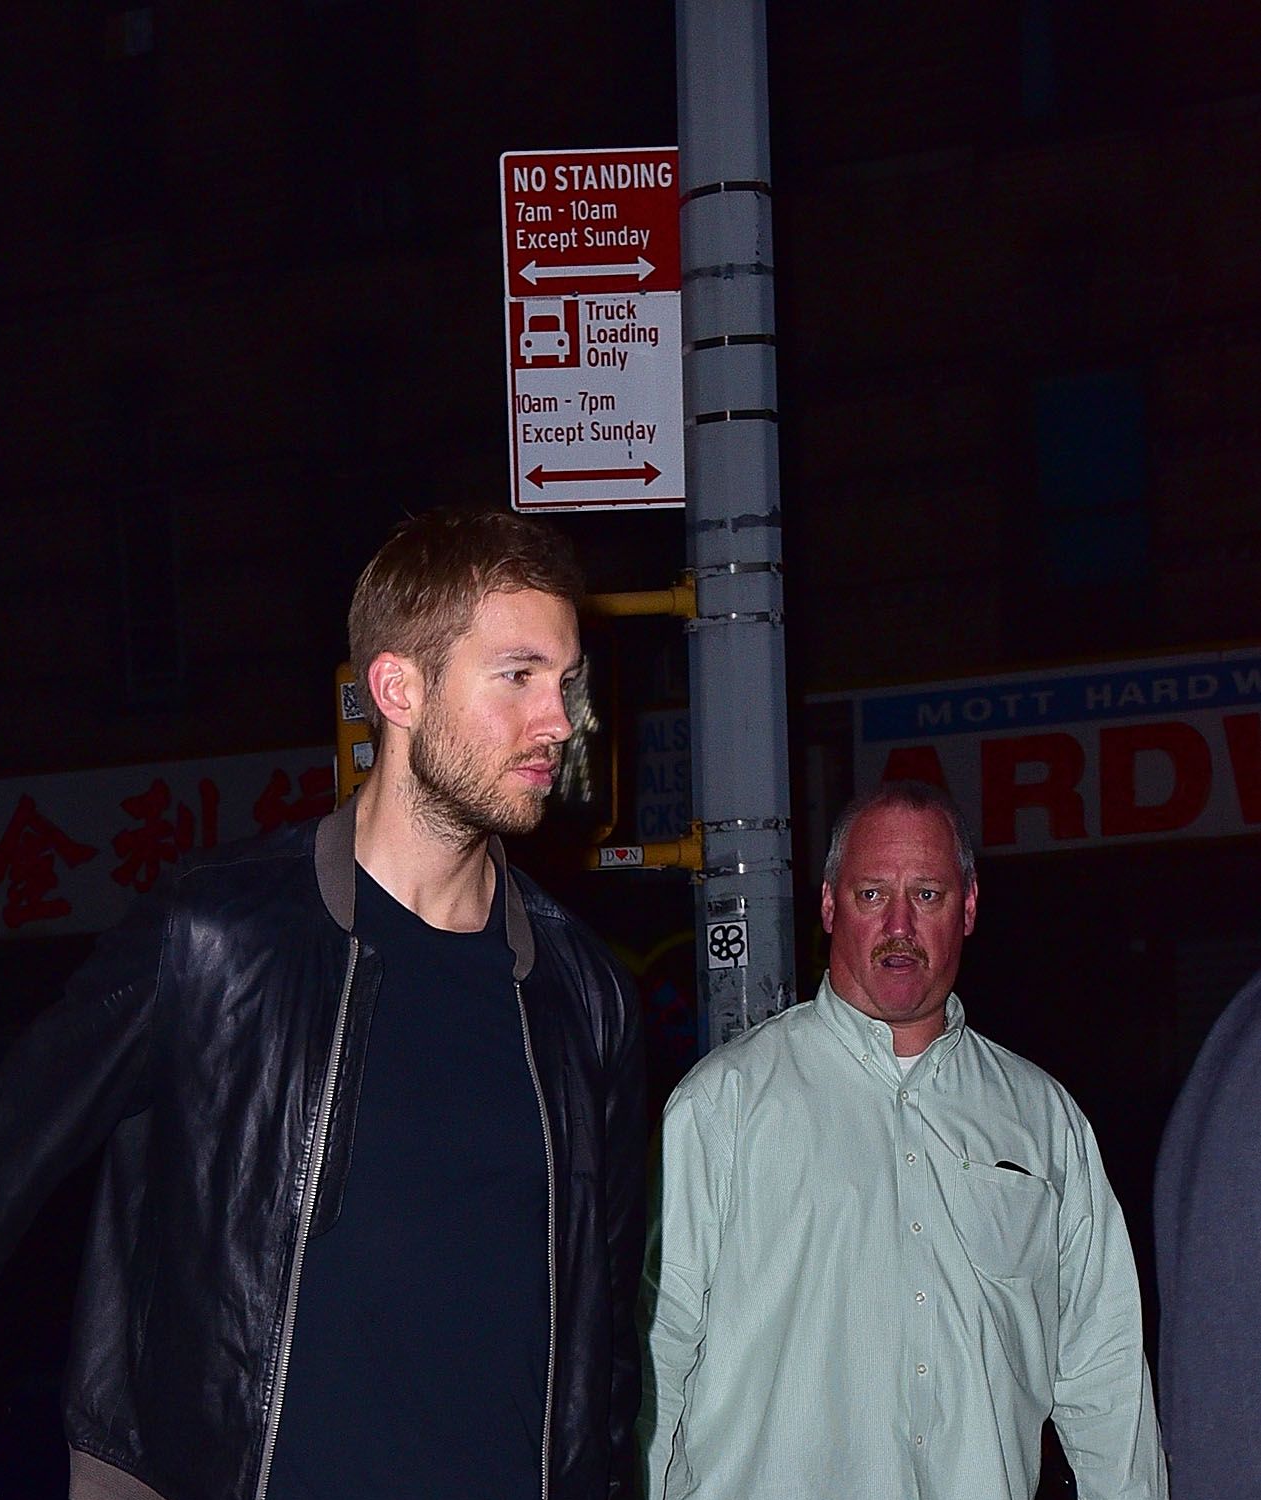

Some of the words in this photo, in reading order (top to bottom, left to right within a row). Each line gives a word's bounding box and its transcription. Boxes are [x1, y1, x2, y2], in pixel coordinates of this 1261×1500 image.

[513, 166, 547, 192] NO
[554, 162, 673, 192] STANDING
[514, 201, 552, 222] 7am
[569, 199, 618, 221] 10am
[515, 227, 578, 253] Except
[583, 225, 651, 250] Sunday
[585, 299, 637, 321] Truck
[586, 322, 659, 347] Loading
[587, 346, 628, 371] Only
[516, 393, 558, 414] 10am
[577, 391, 616, 415] 7pm
[522, 422, 585, 446] Except
[590, 419, 657, 444] Sunday
[915, 690, 1057, 729] MOTT
